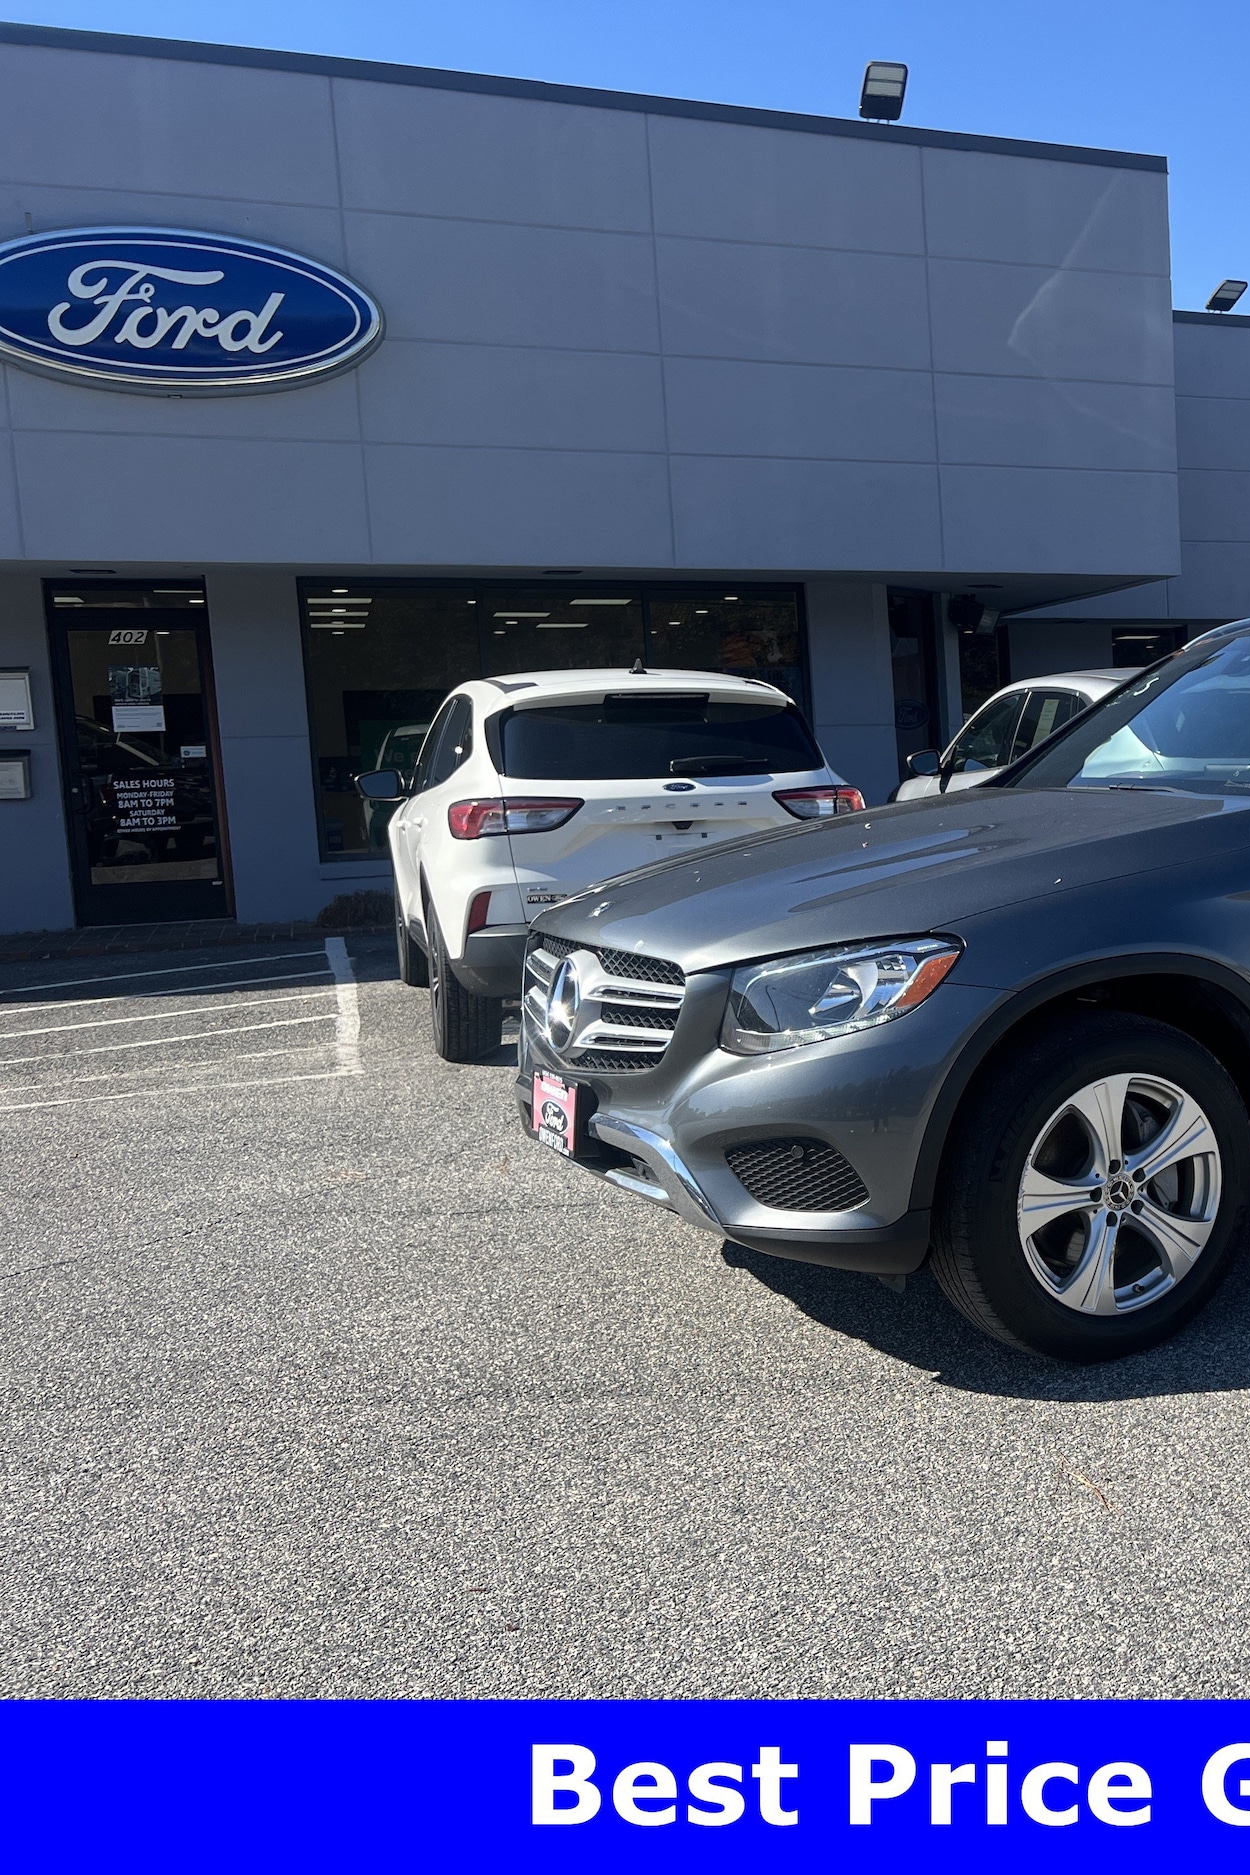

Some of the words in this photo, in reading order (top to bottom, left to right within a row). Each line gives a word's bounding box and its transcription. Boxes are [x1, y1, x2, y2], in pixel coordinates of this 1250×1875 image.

[48, 259, 286, 354] Ford
[110, 630, 145, 643] 402
[113, 780, 141, 790] SALES
[142, 779, 175, 788] HOURS
[116, 790, 174, 799] MONDAY-FRIDAY
[118, 800, 138, 808] 8AM
[140, 799, 153, 807] TO
[154, 798, 175, 807] 7PM
[129, 809, 165, 817] SATURDAY
[120, 818, 141, 827] 8AM
[142, 817, 155, 826] TO
[157, 816, 177, 825] 3PM
[545, 1102, 565, 1131] Ford
